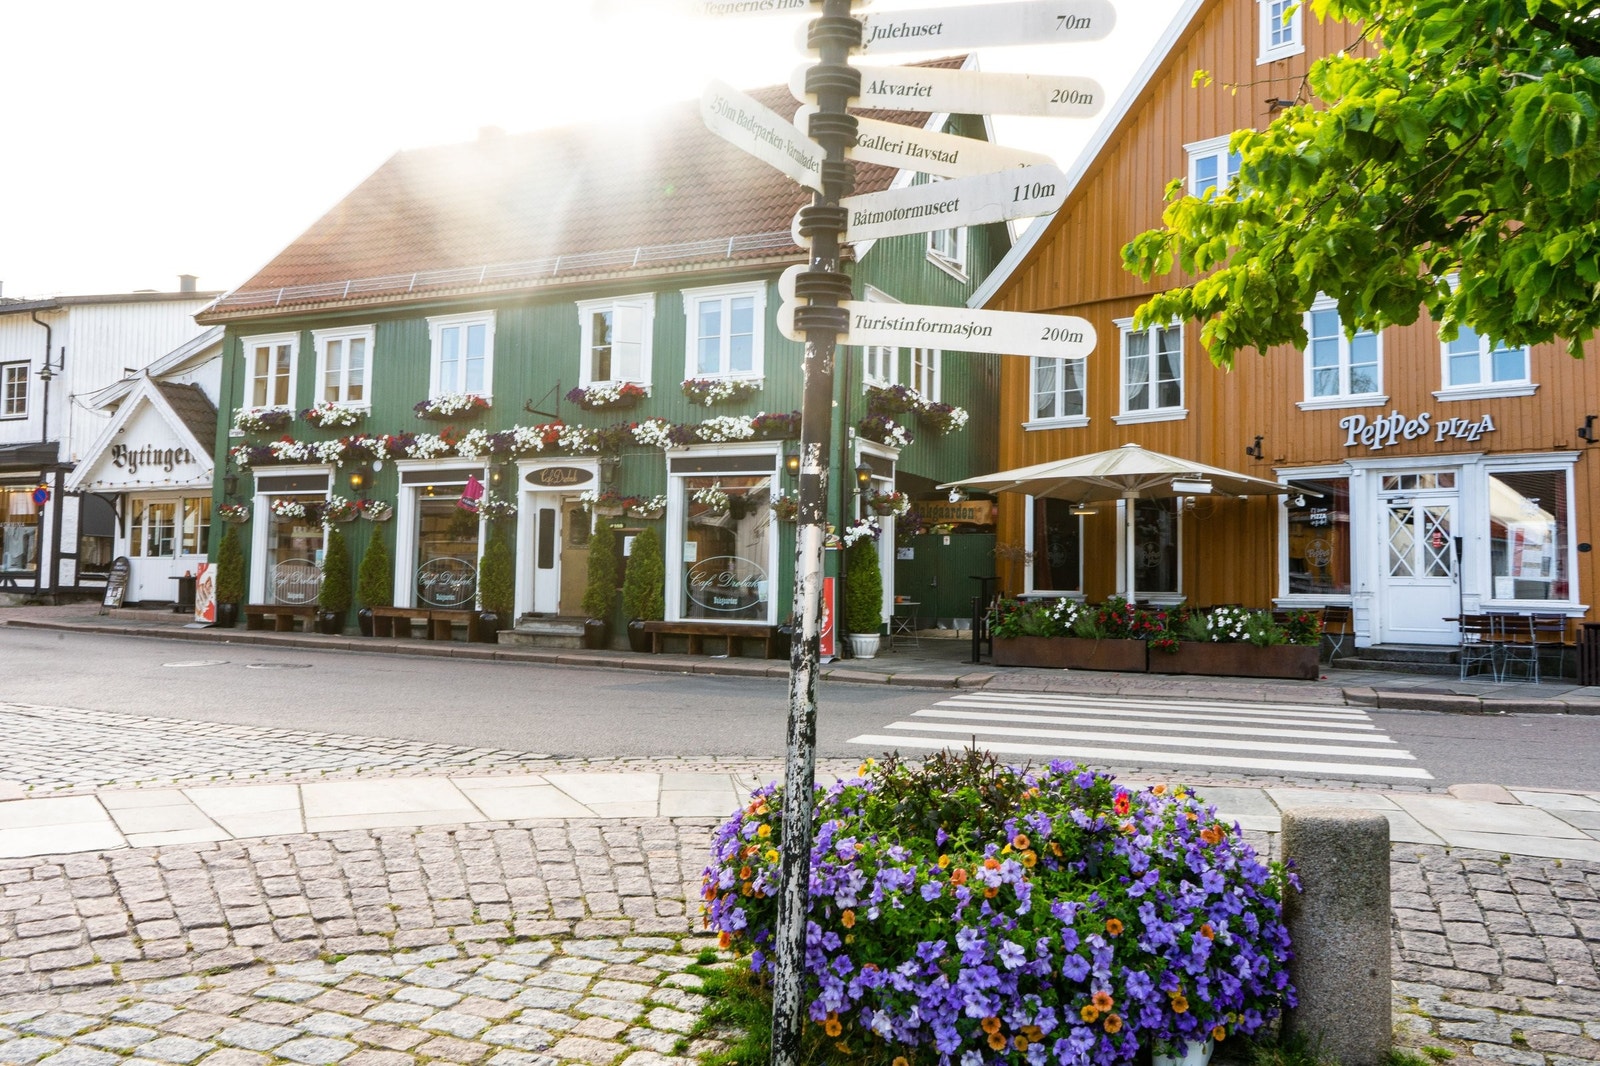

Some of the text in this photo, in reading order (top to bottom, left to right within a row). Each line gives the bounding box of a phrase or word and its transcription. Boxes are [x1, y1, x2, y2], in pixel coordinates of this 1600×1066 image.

[777, 0, 805, 9] Hus
[868, 14, 1091, 43] Julehuset 70m
[866, 80, 1093, 105] Akvariet 200m
[710, 94, 736, 121] 250m
[736, 109, 784, 150] Badeparken
[857, 133, 959, 164] Galleri Havstad
[852, 182, 1056, 227] Båtmotormuseet 110m
[854, 314, 1084, 343] Turistinformasjon 200m
[1339, 409, 1431, 450] Peppes
